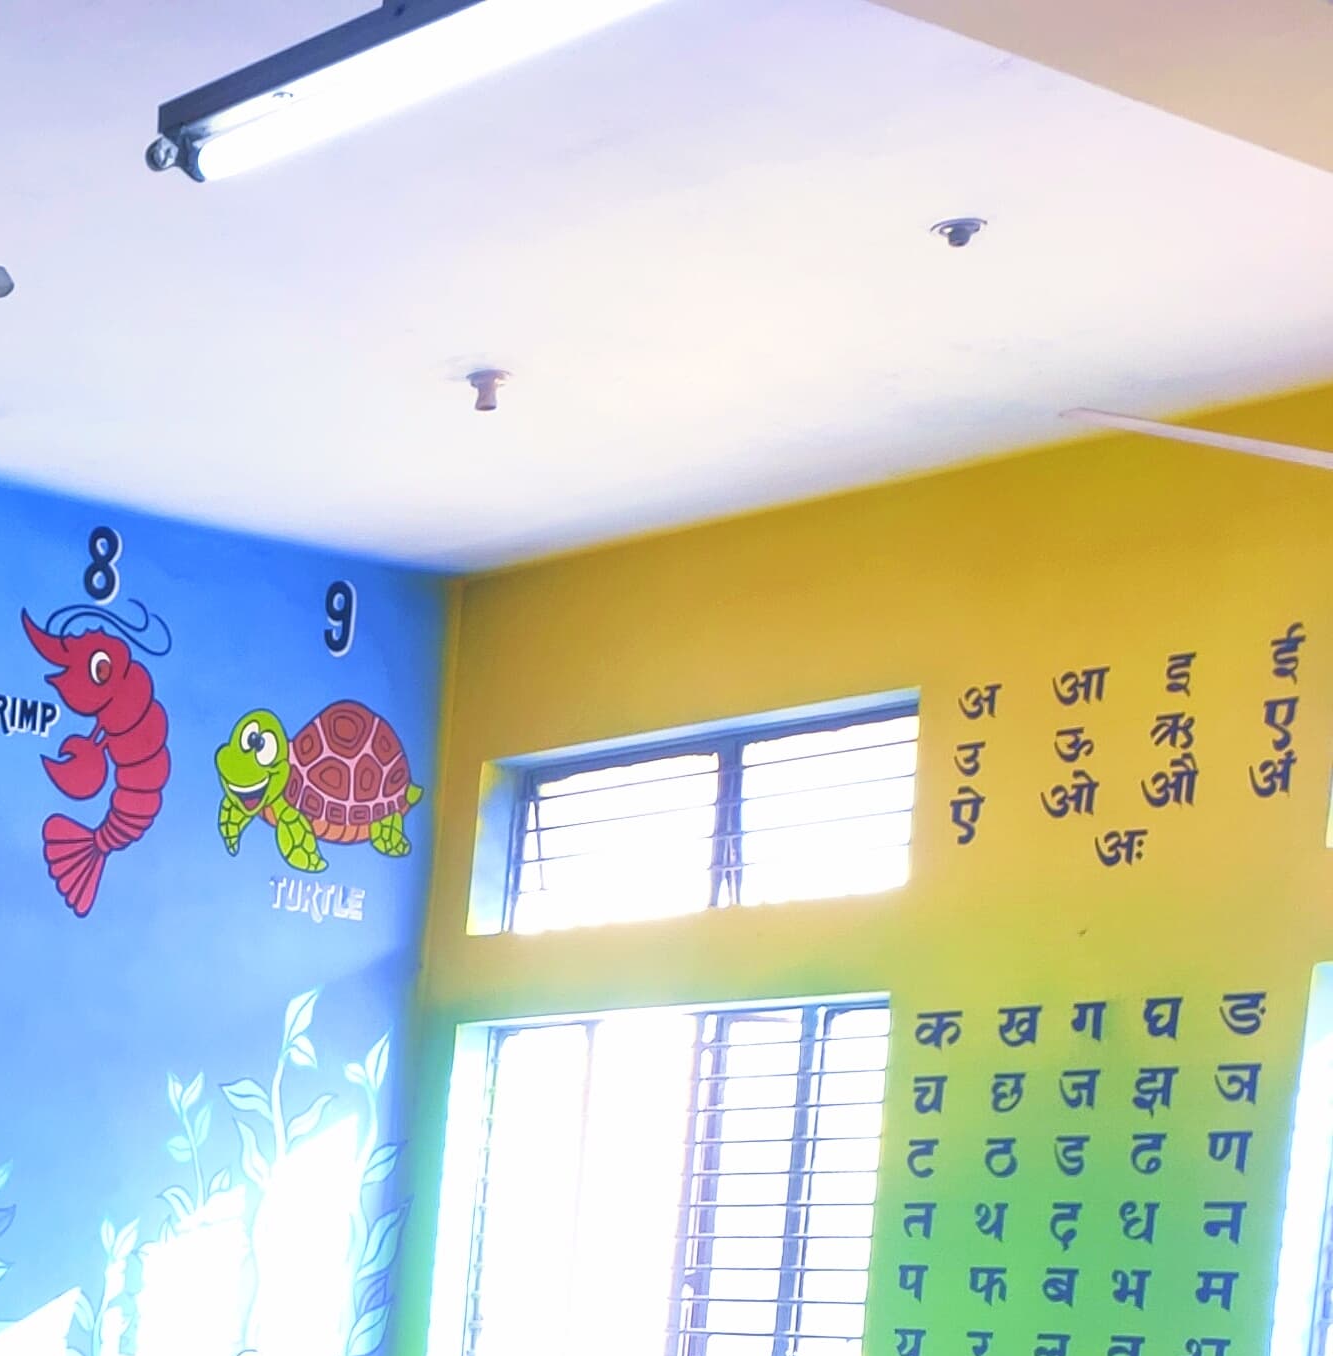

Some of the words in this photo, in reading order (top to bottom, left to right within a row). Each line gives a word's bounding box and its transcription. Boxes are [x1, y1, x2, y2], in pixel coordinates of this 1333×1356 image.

[84, 525, 121, 603] 8
[324, 580, 357, 656] 9
[959, 684, 1002, 720] अ
[1053, 667, 1110, 706] आ
[1166, 652, 1197, 696] इ
[1271, 622, 1306, 684] ई
[954, 741, 986, 777] उ
[1054, 727, 1094, 763] ऊ
[1150, 712, 1195, 749] ऋ
[1264, 696, 1299, 751] ए
[950, 786, 986, 845] ऐ
[1041, 770, 1099, 818] ओ
[1141, 752, 1199, 808] औ
[1249, 749, 1297, 798] अं
[1095, 829, 1148, 867] अः
[269, 875, 367, 921] TURTLE
[915, 1011, 963, 1049] क
[998, 1005, 1042, 1047] ख
[1071, 1002, 1107, 1041] ग
[1143, 997, 1183, 1040] घ
[1220, 992, 1266, 1035] ङ
[914, 1076, 948, 1114] च
[992, 1073, 1026, 1112] छ
[1060, 1069, 1101, 1109] ज
[1132, 1067, 1179, 1117] झ
[1215, 1064, 1261, 1104] ञ
[908, 1139, 939, 1178] ट
[985, 1138, 1017, 1178] ठ
[1055, 1136, 1090, 1176] ड
[1131, 1133, 1166, 1174] ढ
[1208, 1131, 1253, 1173] ण
[904, 1203, 937, 1238] त
[975, 1203, 1008, 1242] थ
[1051, 1203, 1082, 1251] द
[1120, 1201, 1159, 1244] ध
[1204, 1202, 1247, 1244] न
[899, 1265, 928, 1302] प
[970, 1267, 1007, 1305] फ
[1043, 1268, 1079, 1307] ब
[1112, 1270, 1151, 1310] भ
[1196, 1272, 1239, 1310] म
